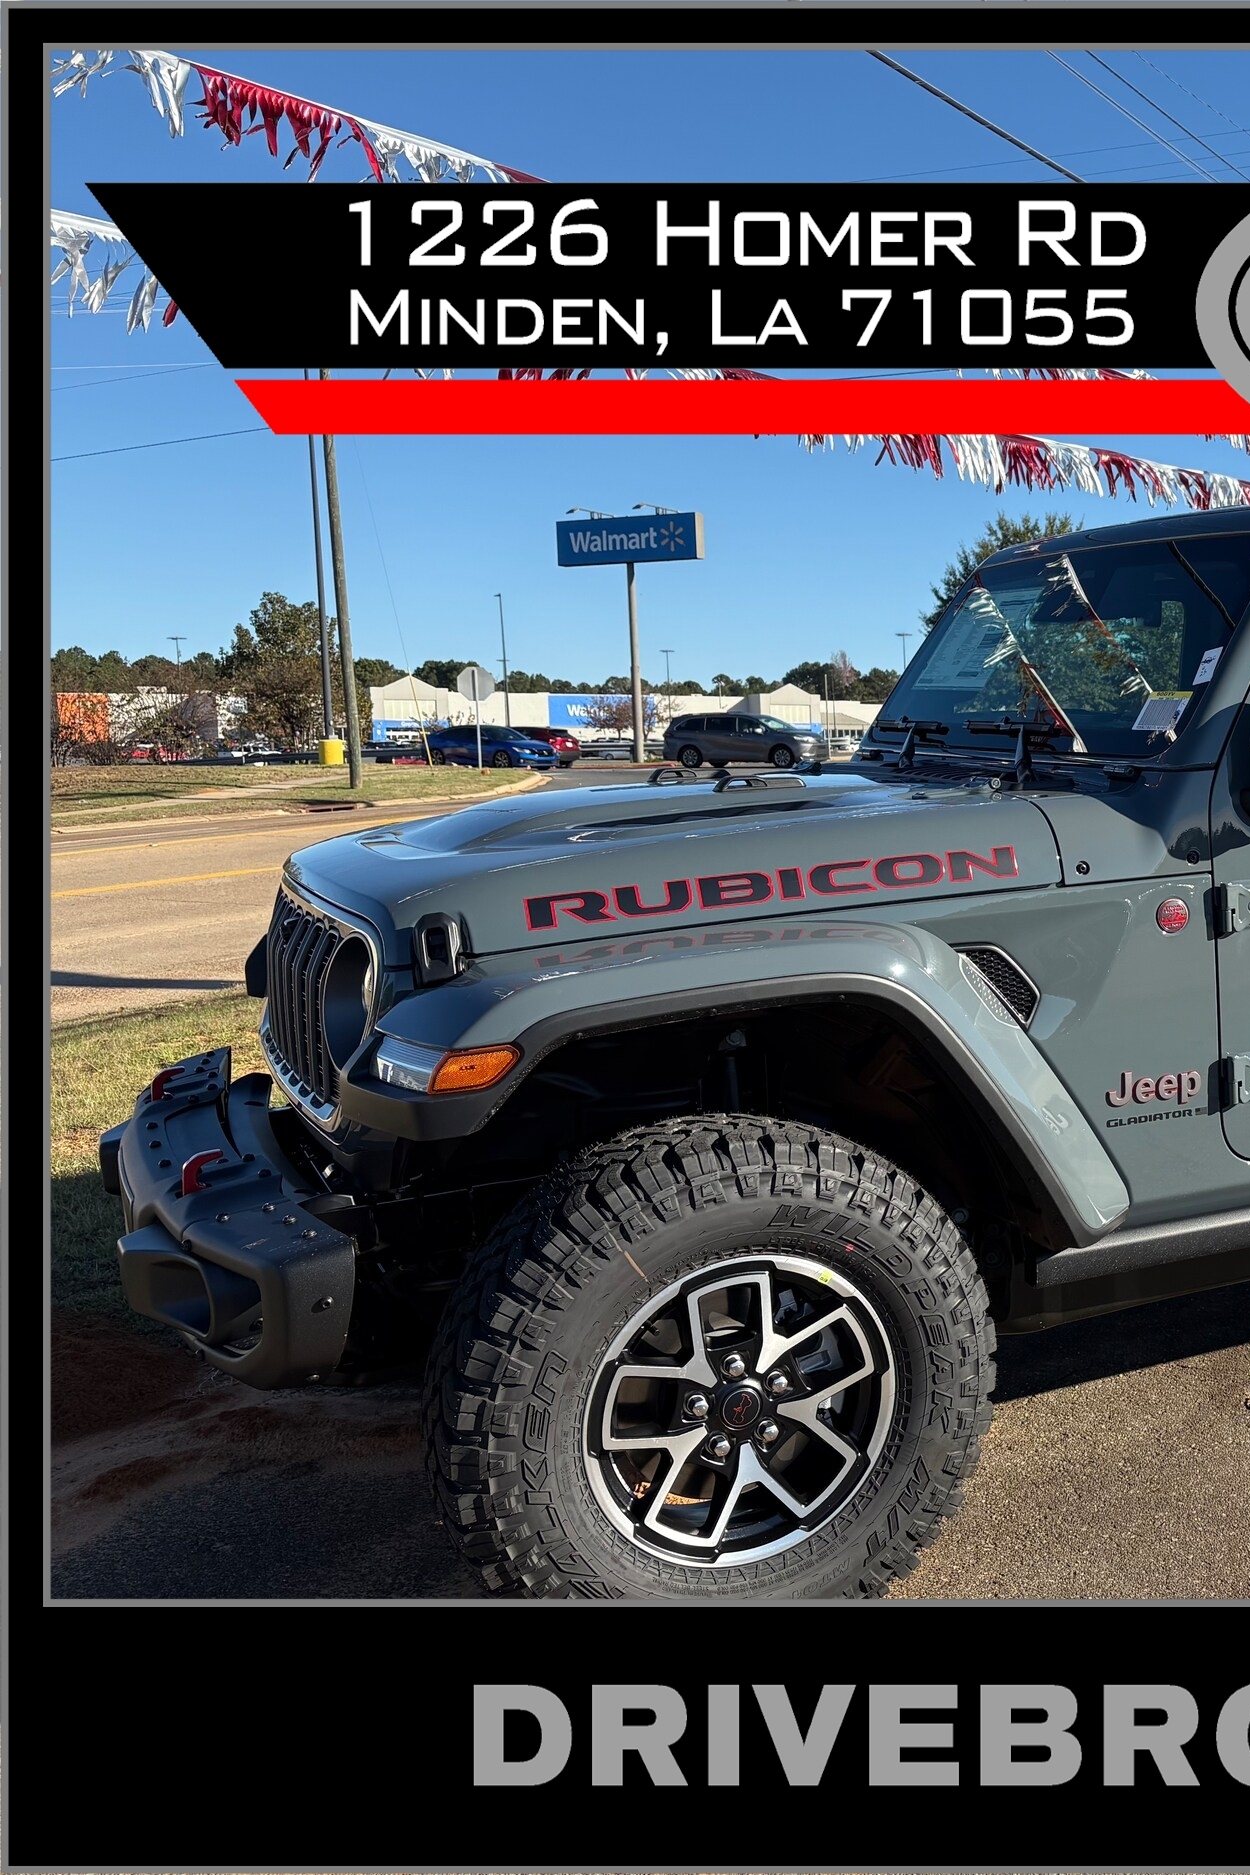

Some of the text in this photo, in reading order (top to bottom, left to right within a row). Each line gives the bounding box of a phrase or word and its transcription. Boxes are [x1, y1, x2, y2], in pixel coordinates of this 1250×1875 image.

[569, 527, 657, 554] Walmart
[523, 846, 1018, 929] RUBICON
[1105, 1070, 1202, 1108] Jeep
[1106, 1108, 1193, 1129] GLADIATOR
[766, 1203, 954, 1434] WILDPEAK
[863, 1454, 931, 1568] M/T
